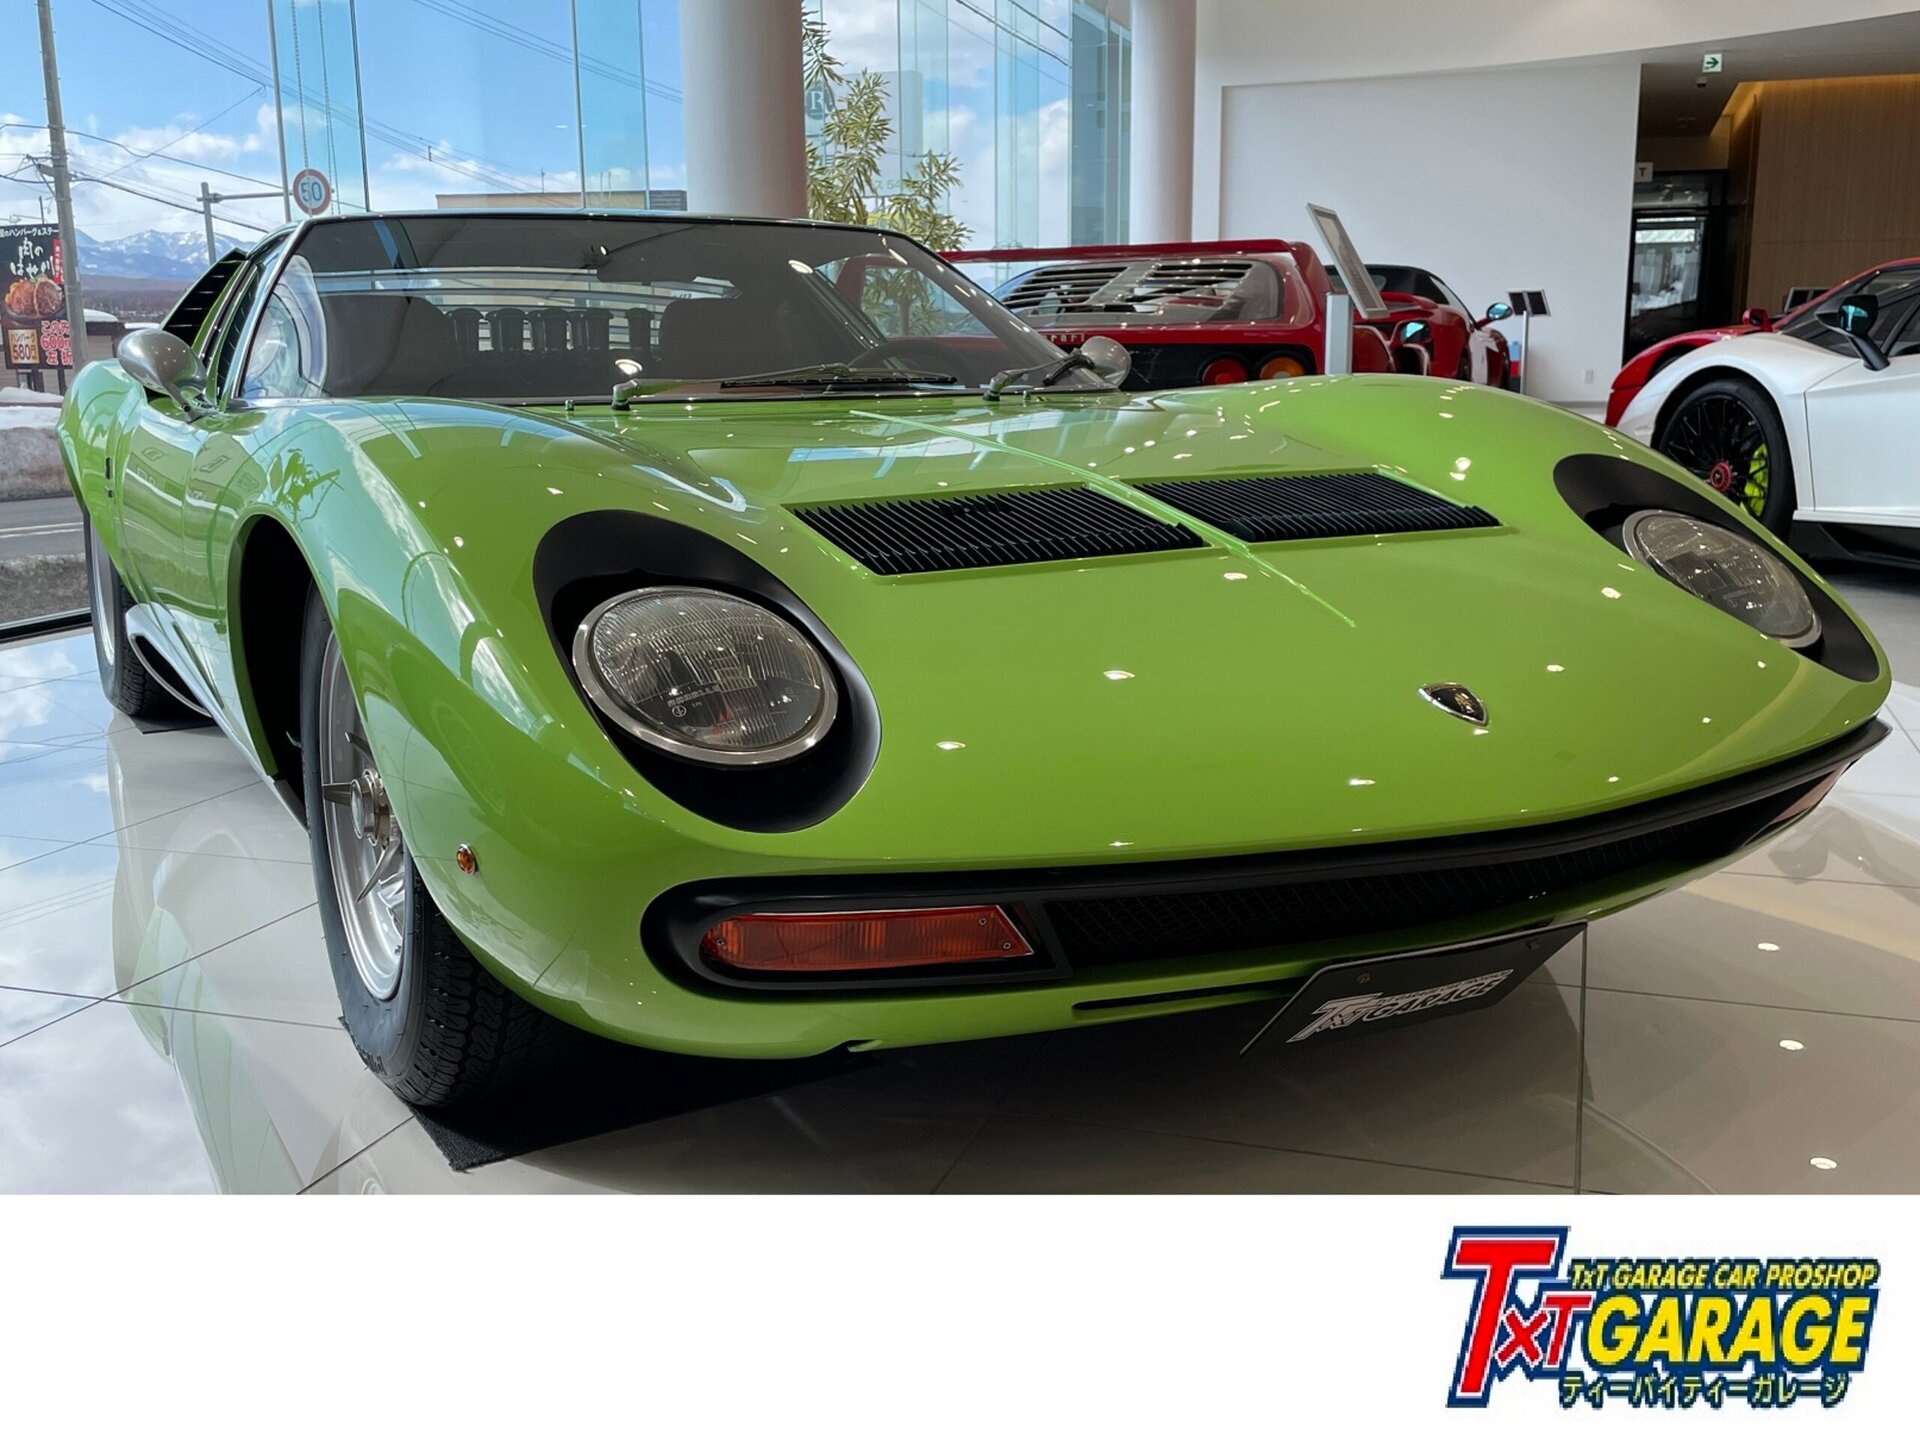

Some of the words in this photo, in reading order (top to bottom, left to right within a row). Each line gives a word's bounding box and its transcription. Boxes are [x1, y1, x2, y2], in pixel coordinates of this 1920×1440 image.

[301, 181, 322, 202] 50
[13, 344, 37, 360] 580円
[1363, 979, 1508, 1021] GARAGE
